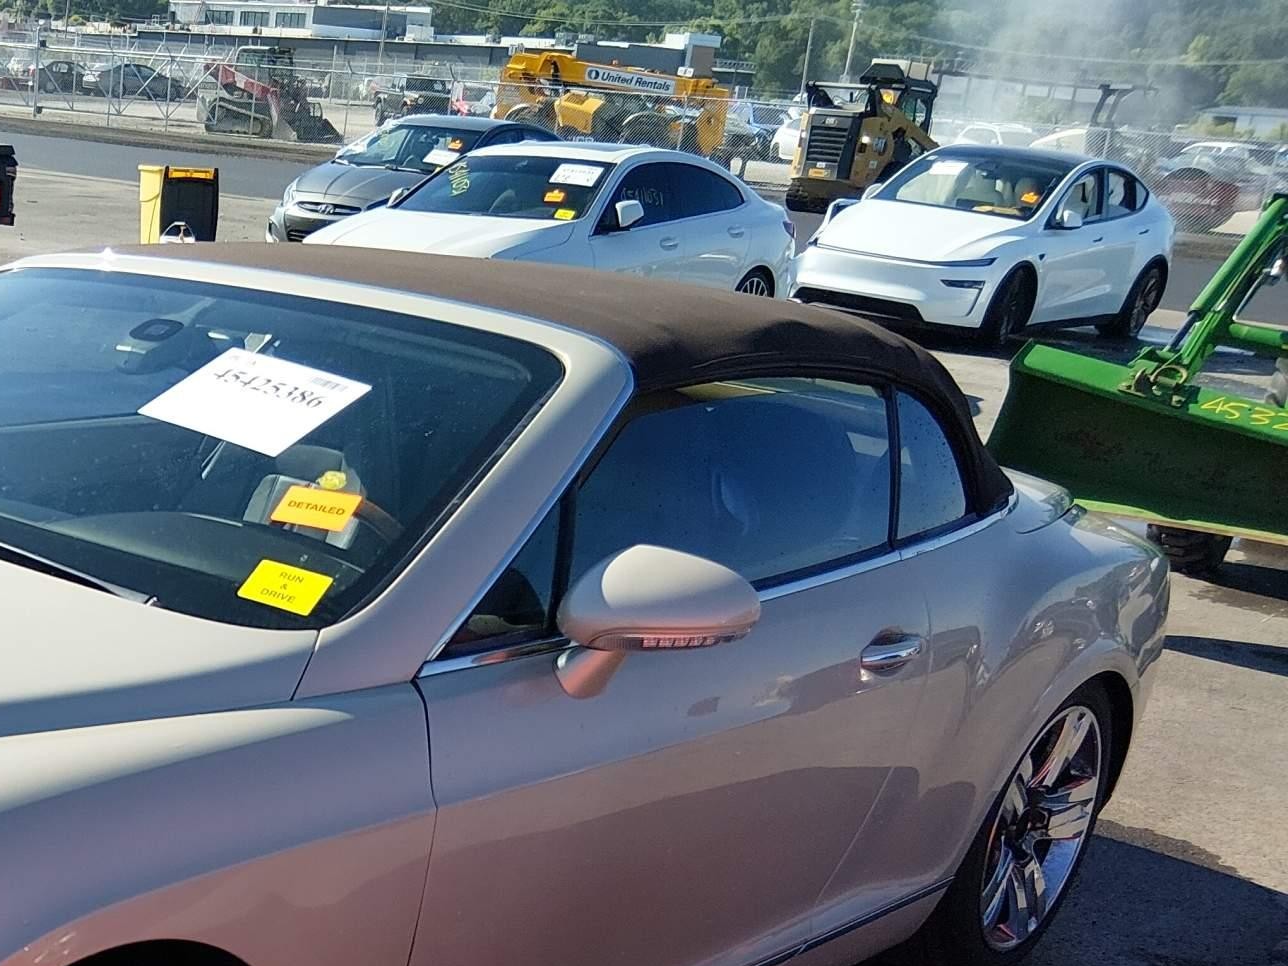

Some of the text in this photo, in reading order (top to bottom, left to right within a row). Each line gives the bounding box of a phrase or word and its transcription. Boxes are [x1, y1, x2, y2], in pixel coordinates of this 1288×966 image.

[601, 71, 671, 92] United Rentals
[213, 368, 326, 408] 45425386
[287, 499, 346, 517] DETAILED
[279, 571, 305, 584] RUN
[259, 587, 296, 605] DRIVE
[280, 583, 289, 591] &
